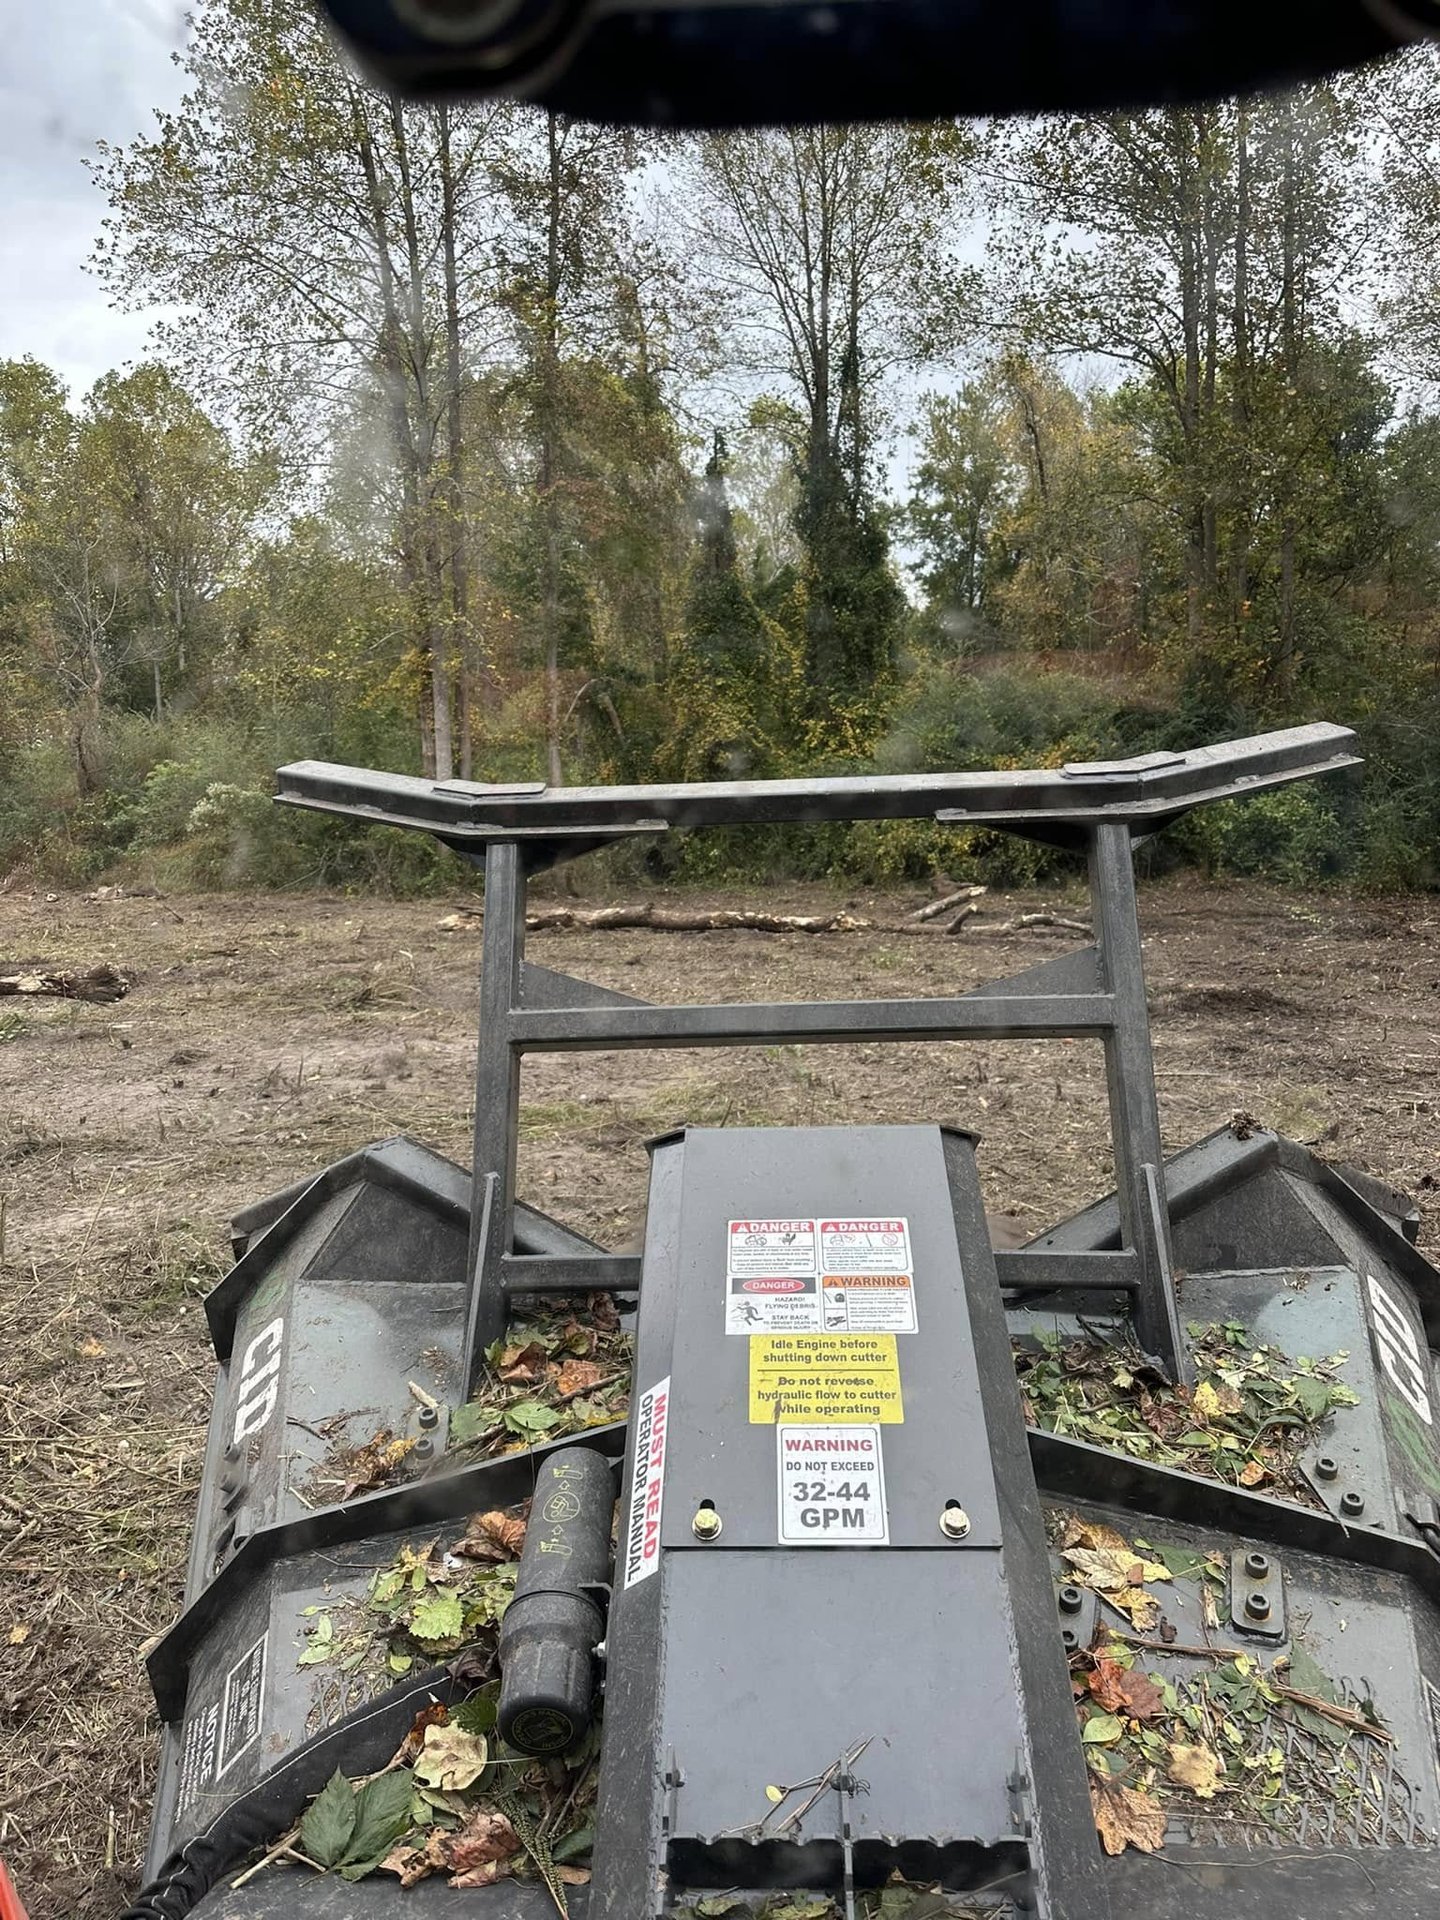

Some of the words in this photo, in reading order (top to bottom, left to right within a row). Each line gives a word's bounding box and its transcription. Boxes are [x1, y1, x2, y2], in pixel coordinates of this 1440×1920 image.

[751, 1222, 811, 1233] DANGER
[839, 1222, 900, 1232] DANGER
[752, 1281, 796, 1290] DANGER
[841, 1276, 907, 1287] WARNING
[771, 1340, 793, 1349] Idle
[797, 1340, 836, 1351] Engine
[840, 1340, 878, 1349] before
[763, 1352, 812, 1364] shutting
[815, 1352, 847, 1362] down
[851, 1353, 887, 1362] cutter
[233, 1317, 283, 1445] CID
[778, 1377, 795, 1386] Do
[799, 1377, 821, 1386] not
[757, 1390, 812, 1401] hydraulic
[815, 1390, 841, 1399] flow
[844, 1391, 857, 1399] to
[860, 1391, 896, 1399] cutter
[815, 1404, 881, 1415] operating
[651, 1393, 667, 1467] MUST
[635, 1394, 654, 1492] OPERATOR
[785, 1439, 873, 1451] WARNING
[786, 1461, 801, 1471] DO
[805, 1461, 828, 1471] NOT
[831, 1461, 874, 1471] EXCEED
[793, 1482, 870, 1501] 32-44
[643, 1478, 661, 1559] READ
[801, 1508, 865, 1528] GPM
[627, 1496, 646, 1582] MANUAL
[200, 1702, 220, 1785] NOTICE
